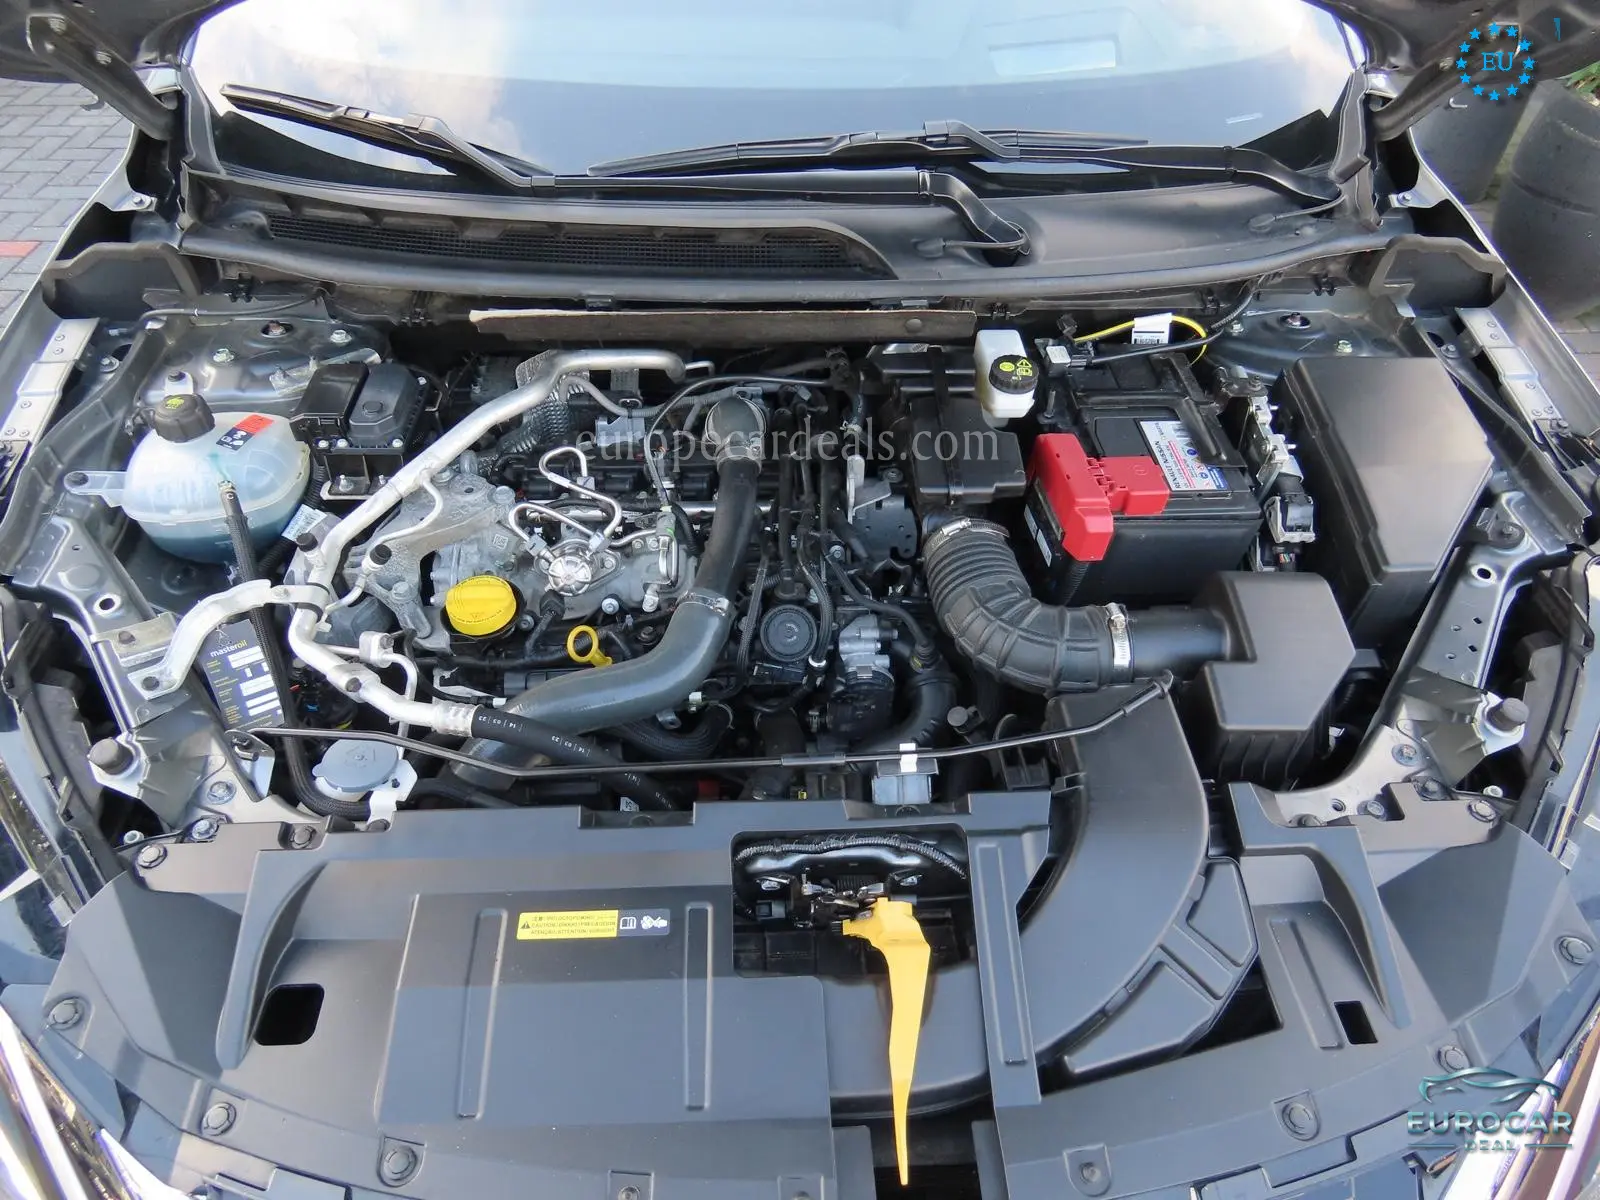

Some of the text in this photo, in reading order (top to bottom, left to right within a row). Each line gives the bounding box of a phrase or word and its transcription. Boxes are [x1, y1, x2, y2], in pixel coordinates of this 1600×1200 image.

[1154, 440, 1168, 464] NISSAN
[1165, 462, 1182, 489] RENAULT
[210, 639, 248, 658] masteroil
